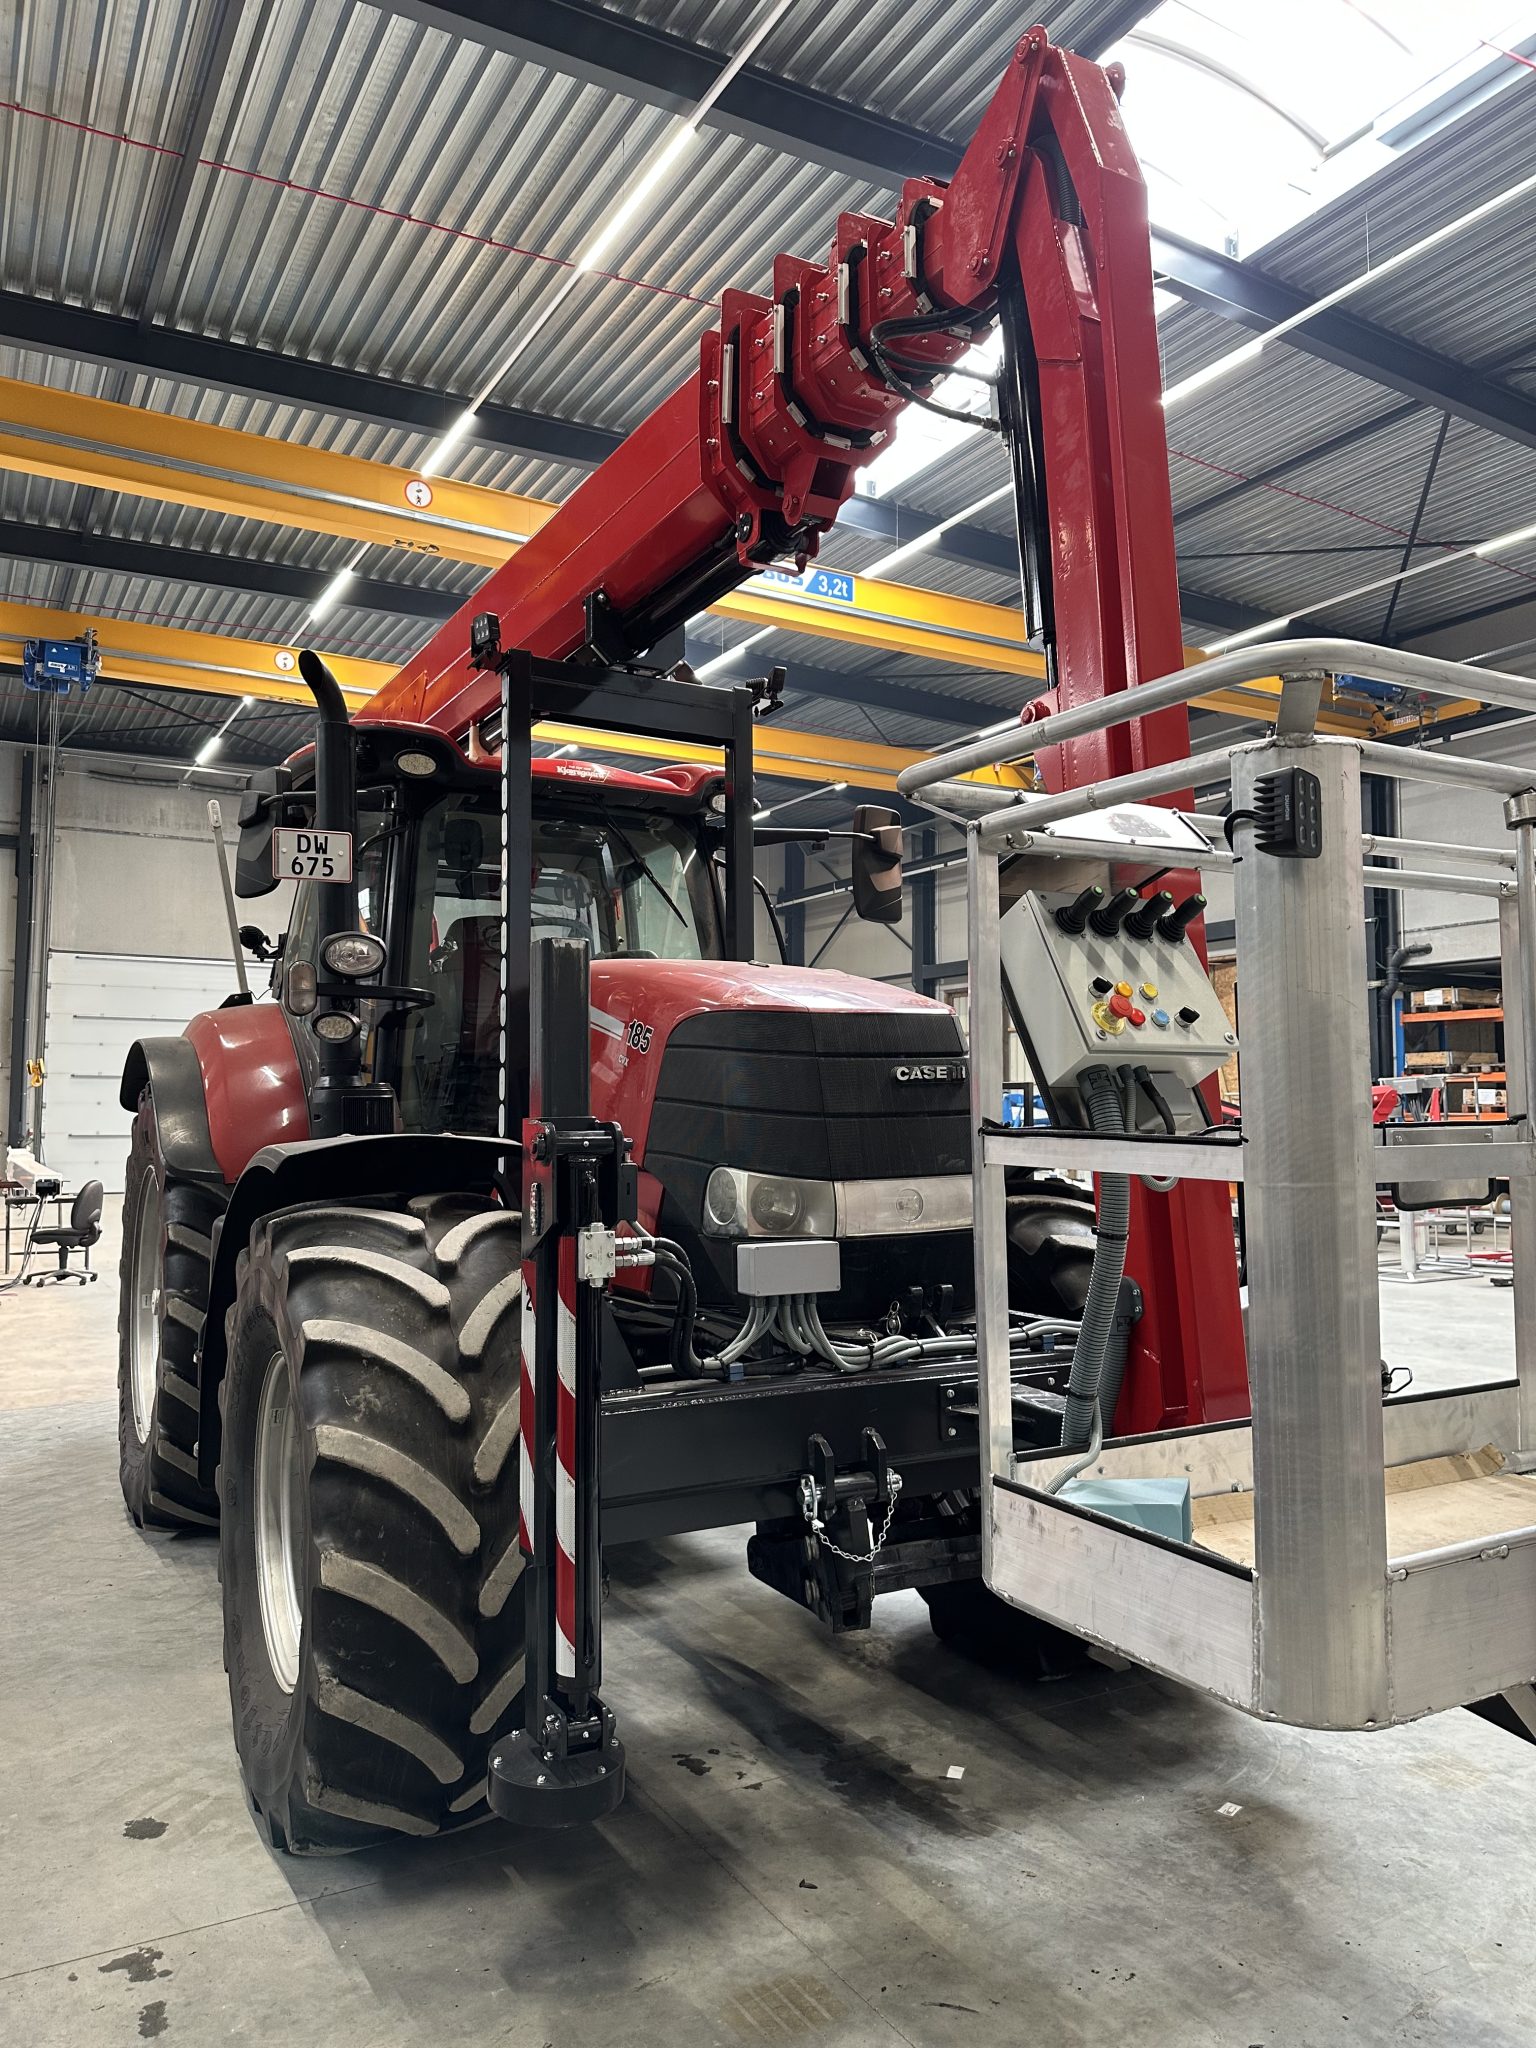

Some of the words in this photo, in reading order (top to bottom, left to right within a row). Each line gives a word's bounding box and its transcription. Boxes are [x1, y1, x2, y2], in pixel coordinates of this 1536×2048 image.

[818, 575, 849, 597] 3,2t
[297, 834, 328, 854] DW
[291, 856, 334, 877] 675
[626, 1018, 654, 1055] 185
[896, 1066, 948, 1081] CASE
